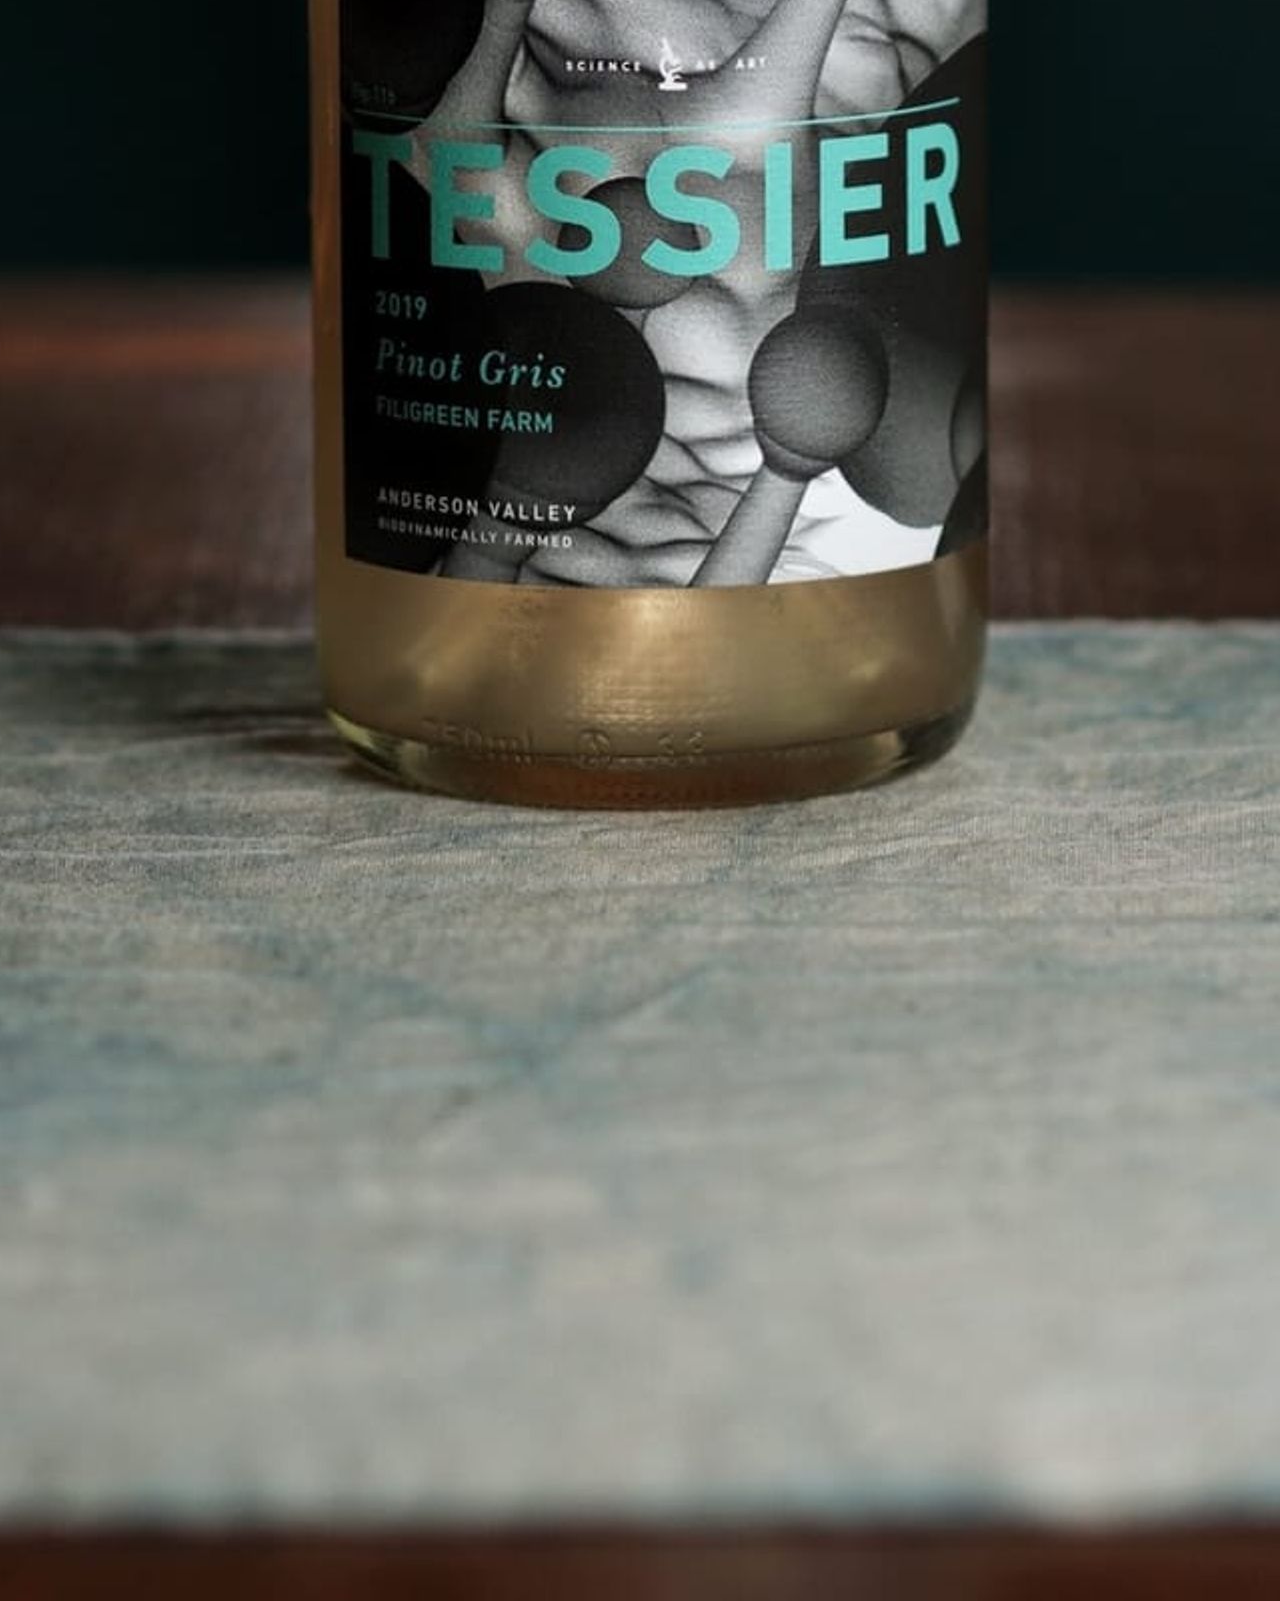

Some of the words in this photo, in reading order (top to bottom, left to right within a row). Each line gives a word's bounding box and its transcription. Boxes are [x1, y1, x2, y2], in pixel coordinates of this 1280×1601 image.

[565, 60, 642, 72] SCIENCE
[735, 57, 768, 70] ART
[352, 122, 962, 278] TESSIER
[374, 289, 428, 321] 2019
[373, 336, 465, 383] Pinot
[478, 349, 568, 390] Gris
[375, 395, 480, 430] FILIGREEN
[486, 407, 556, 434] FARM
[376, 485, 480, 517] ANDERSON
[488, 499, 577, 523] VALLEY
[504, 531, 574, 549] FARMED
